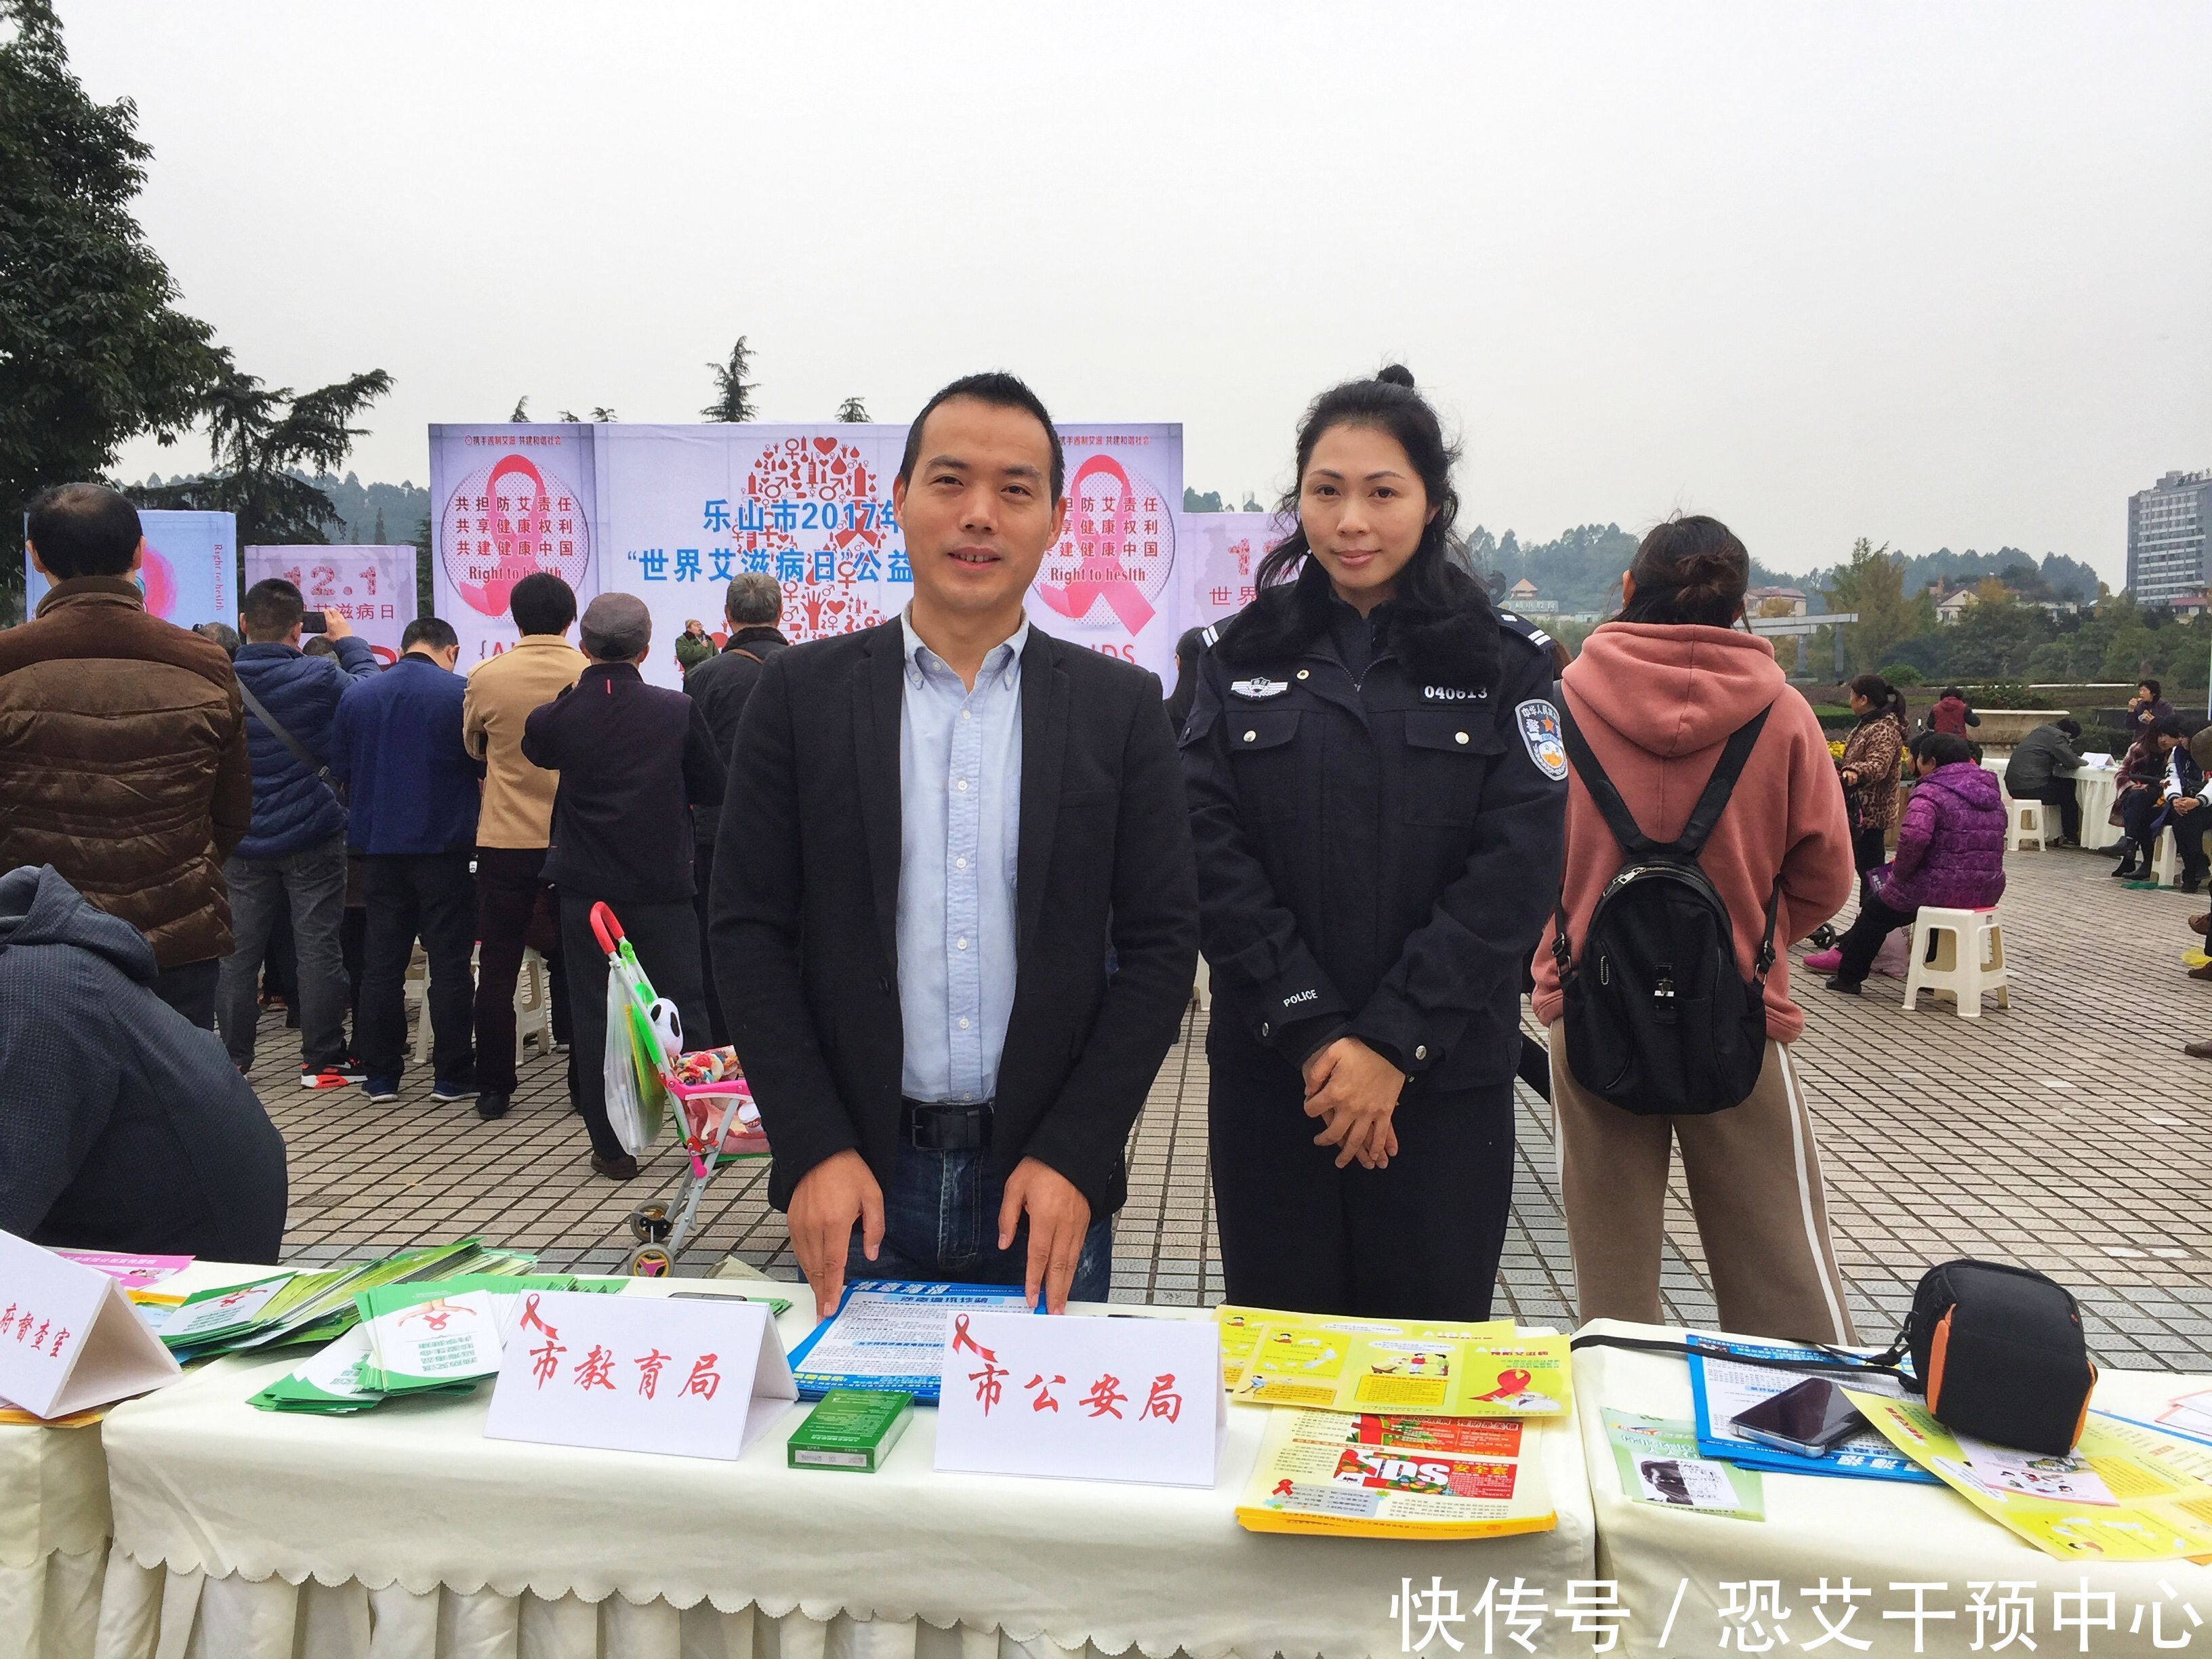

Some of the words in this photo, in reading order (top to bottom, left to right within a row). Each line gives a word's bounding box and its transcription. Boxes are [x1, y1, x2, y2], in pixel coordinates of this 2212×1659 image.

[519, 436, 562, 445] 共建和谐社会
[1106, 436, 1149, 445] 共建和谐社会
[455, 496, 572, 512] 共担防艾责任
[456, 518, 573, 534] 共享健康权利
[457, 540, 573, 557] 共建健康中国
[283, 566, 377, 596] 12.1
[469, 566, 504, 584] Right
[508, 567, 519, 579] to
[1050, 567, 1085, 585] Right
[1090, 568, 1101, 581] to
[1283, 989, 1318, 1007] POLICE
[529, 1340, 722, 1401] 市教育局
[968, 1364, 1184, 1425] 市公安局
